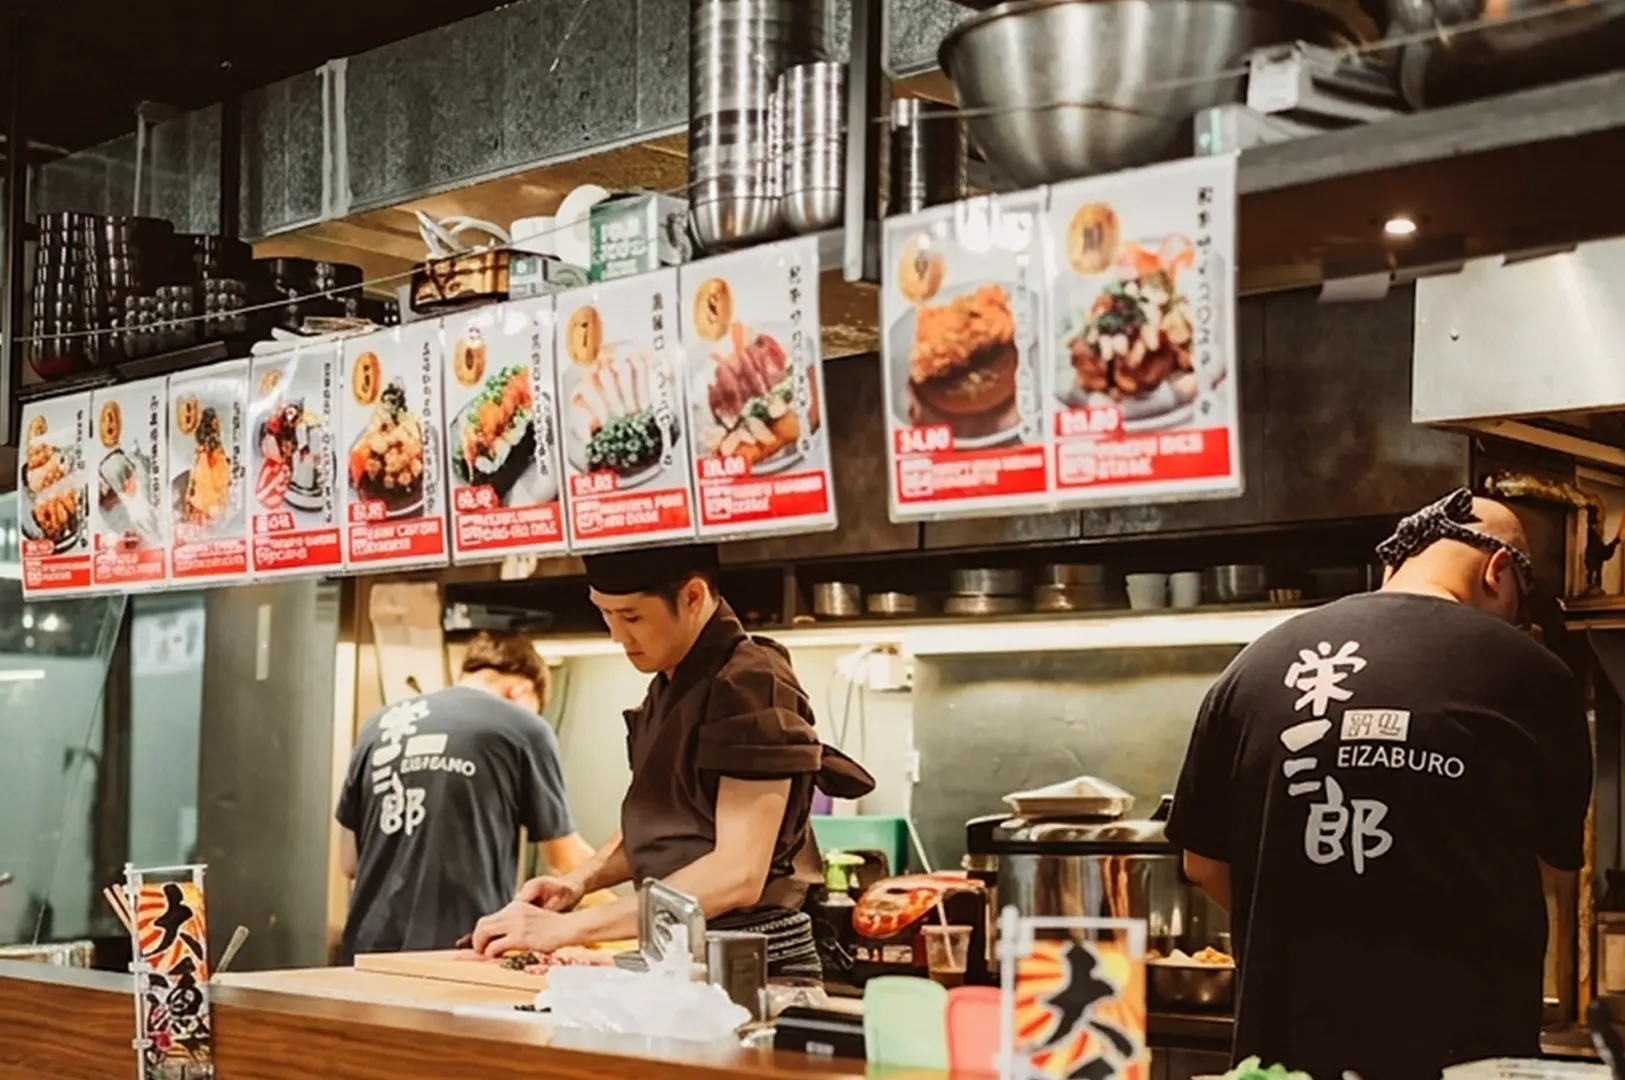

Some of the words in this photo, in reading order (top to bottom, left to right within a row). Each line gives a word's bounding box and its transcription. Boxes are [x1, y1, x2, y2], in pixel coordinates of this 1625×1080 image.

[1280, 640, 1394, 875] 栄三郎
[1337, 745, 1466, 778] EIZABURO
[1016, 942, 1134, 1080] 大
